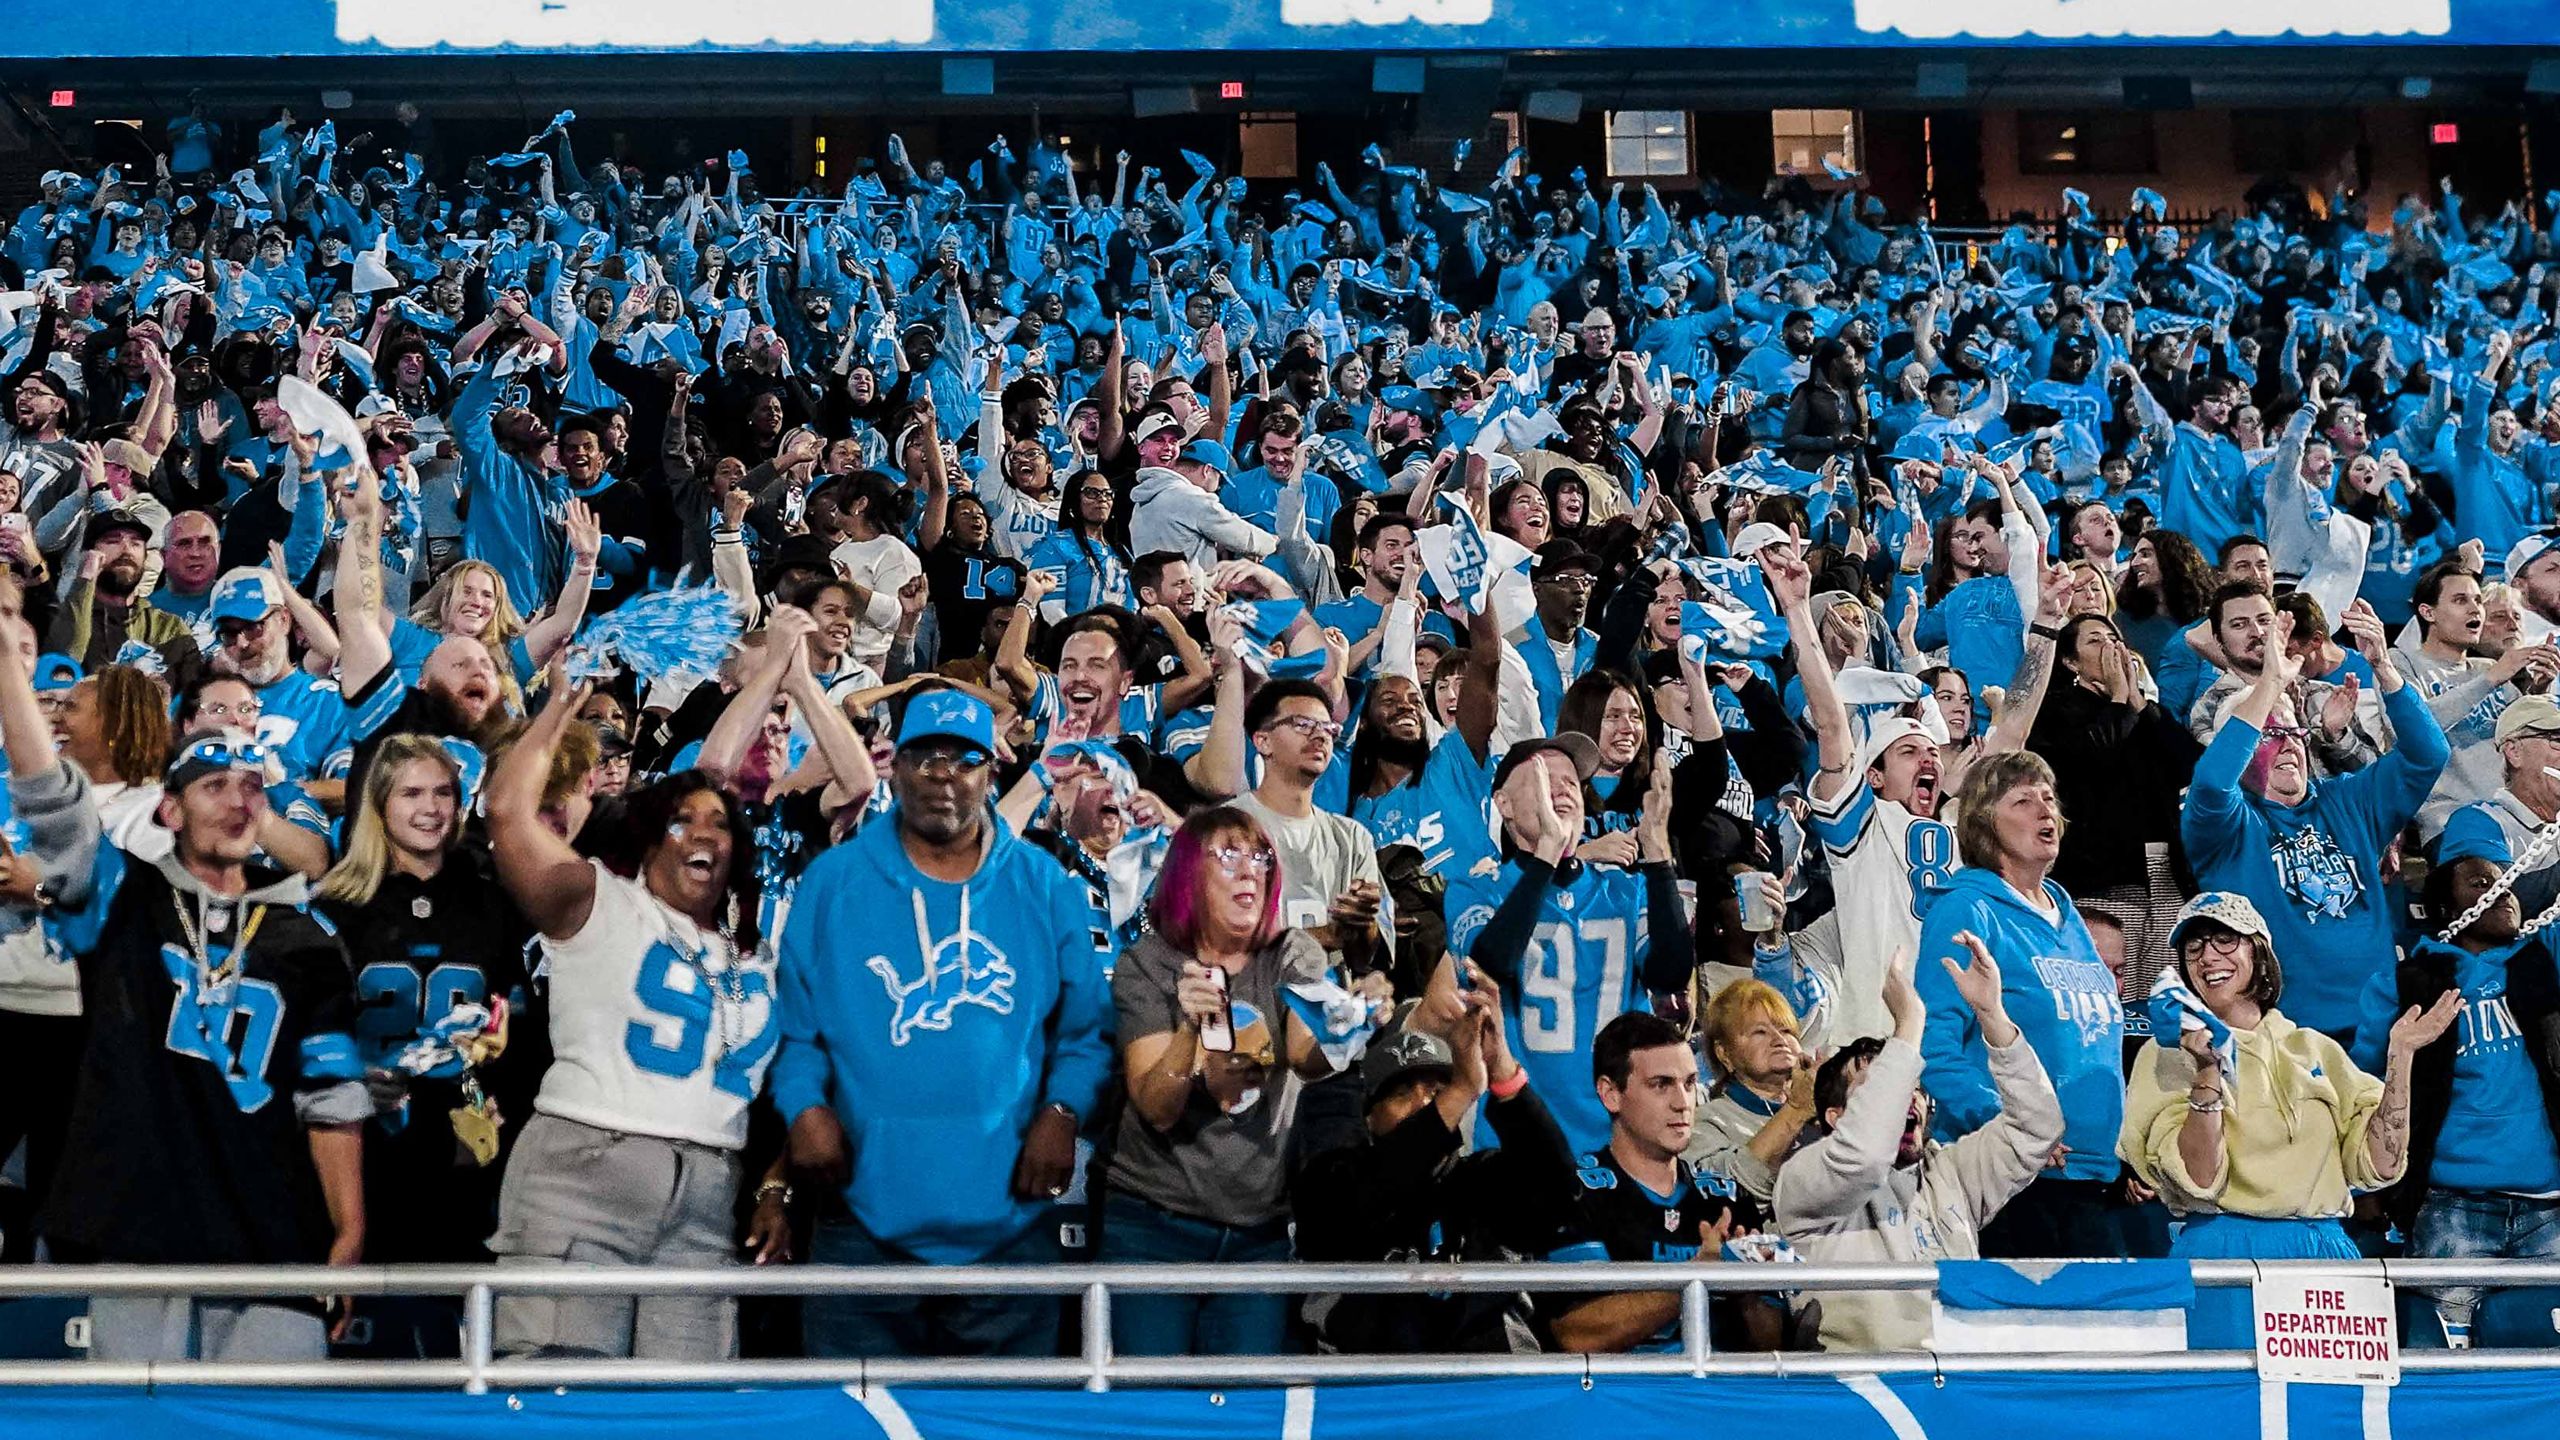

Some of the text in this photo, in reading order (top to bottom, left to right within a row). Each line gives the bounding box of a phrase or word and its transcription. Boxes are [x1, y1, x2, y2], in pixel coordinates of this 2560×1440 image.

[963, 557, 1017, 600] 14
[1522, 916, 1627, 1054] 97
[624, 940, 780, 1102] 92
[2304, 1289, 2346, 1311] FIRE
[2264, 1312, 2388, 1337] DEPARTMENT
[2266, 1336, 2389, 1362] CONNECTION
